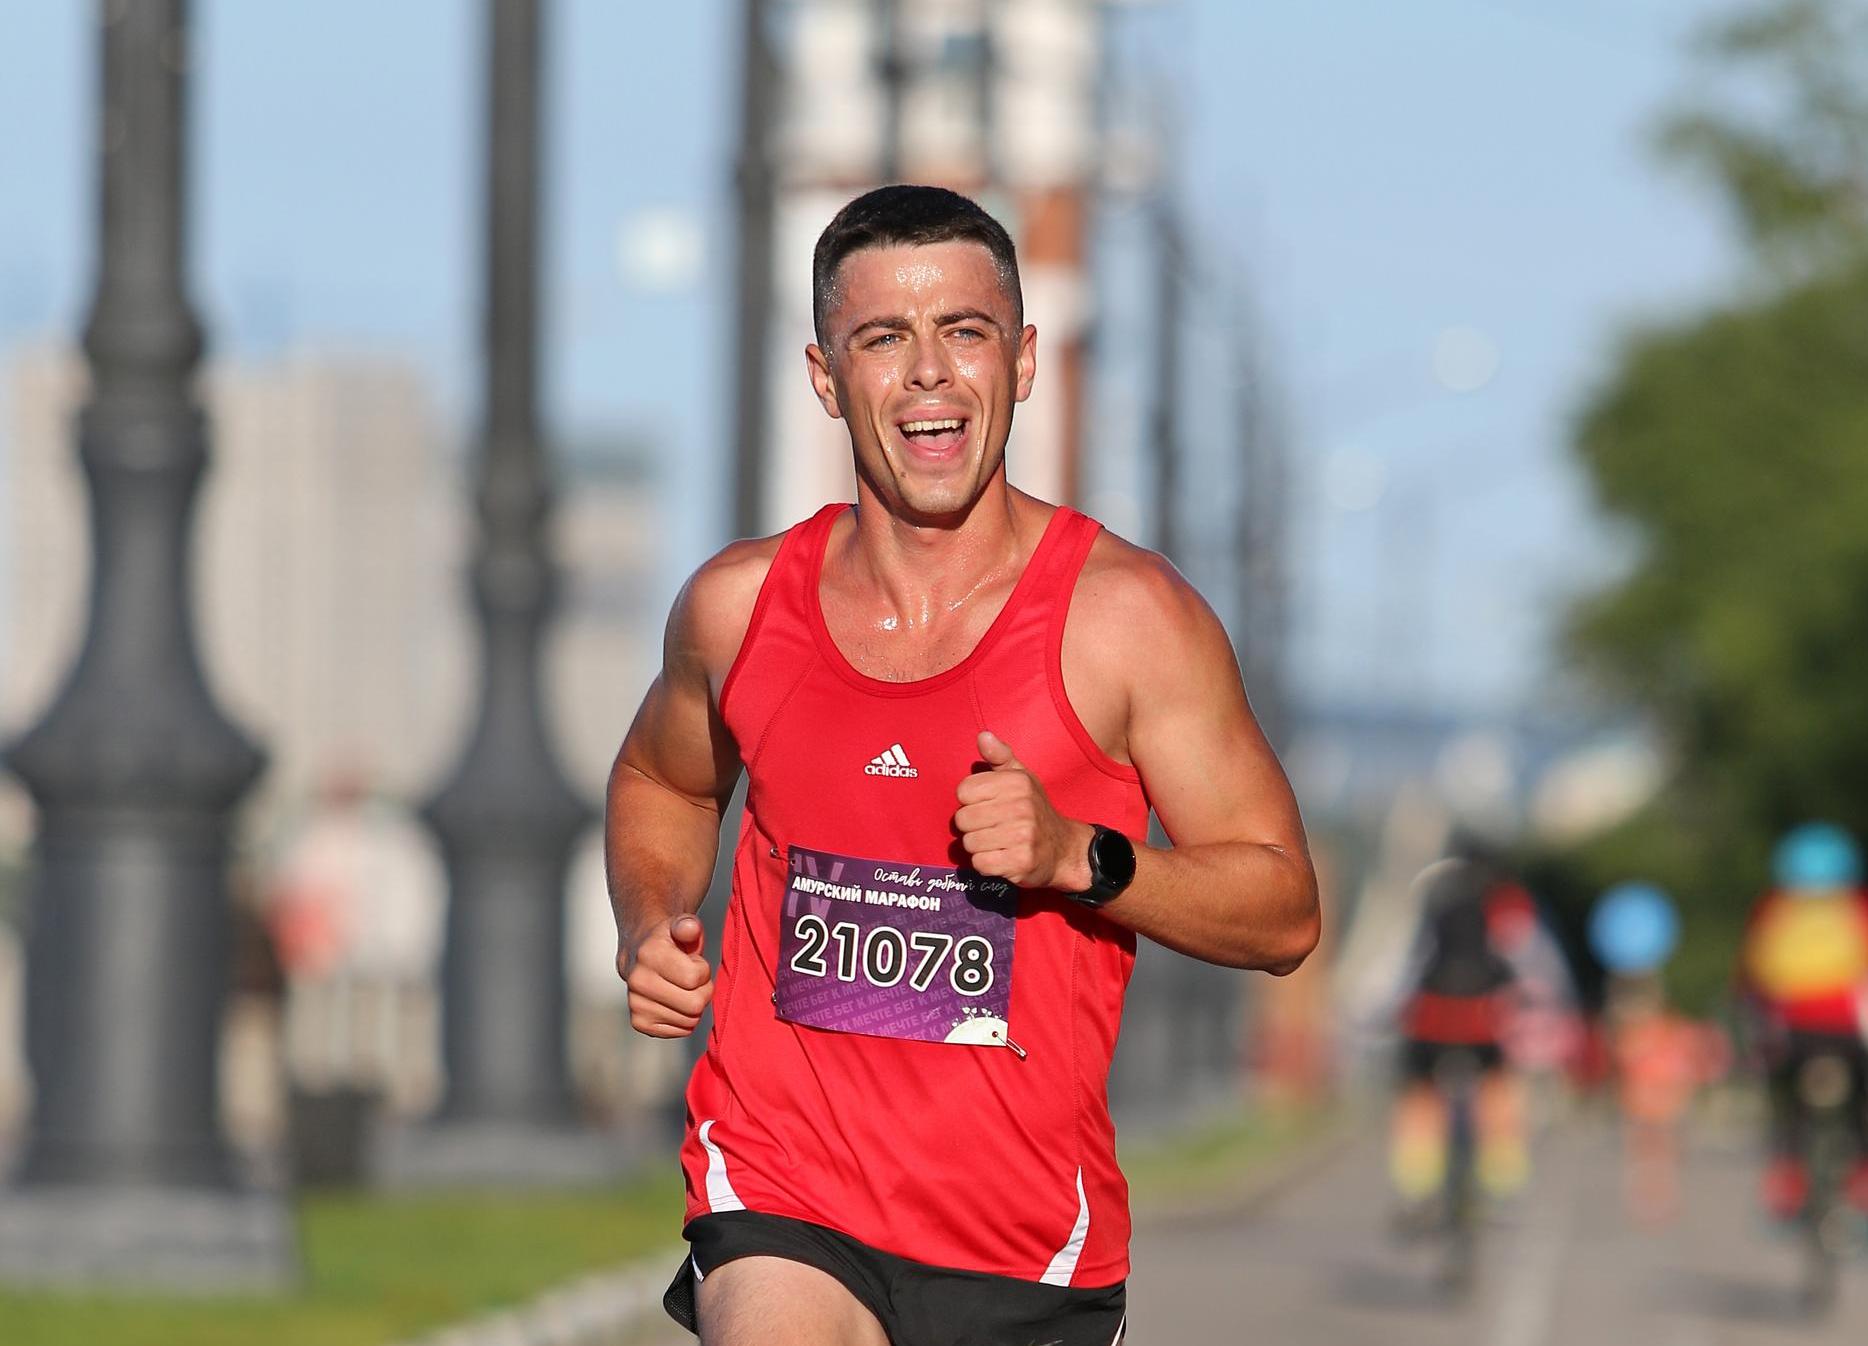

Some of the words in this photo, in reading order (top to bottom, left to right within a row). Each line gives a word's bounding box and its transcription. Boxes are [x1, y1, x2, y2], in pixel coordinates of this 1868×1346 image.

[864, 763, 918, 777] adidas
[874, 867, 924, 887] Оставь
[791, 876, 862, 903] АМУРСКИЙ
[864, 889, 941, 912] МАРАФОН
[791, 915, 994, 997] 21078
